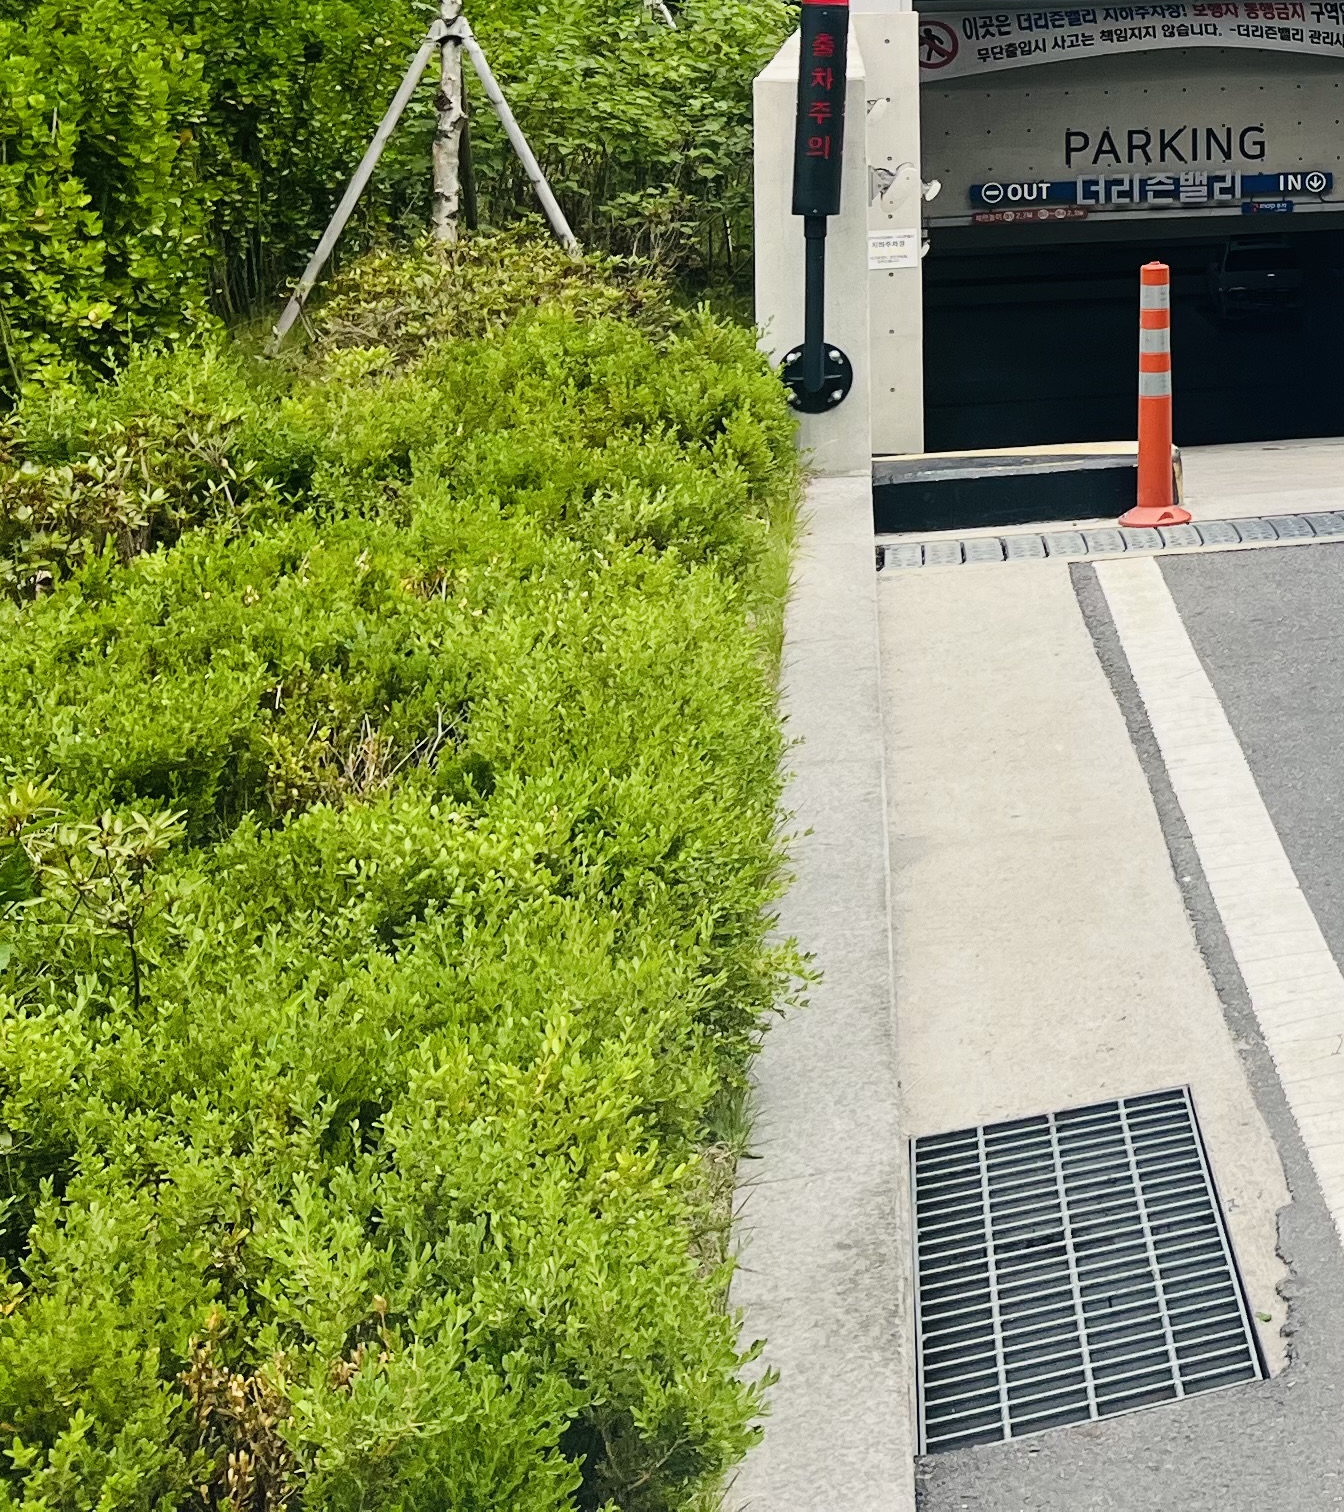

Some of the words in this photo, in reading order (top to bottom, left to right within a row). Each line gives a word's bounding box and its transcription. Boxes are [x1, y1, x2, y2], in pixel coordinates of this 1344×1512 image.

[962, 15, 1011, 40] 이곳은
[1016, 8, 1098, 33] 더리즌밸리
[1103, 3, 1187, 23] 지하주차장!
[1193, 2, 1239, 19] 보행자
[1244, 2, 1306, 23] 통행금지
[977, 37, 1047, 62] 무단출입시
[1051, 32, 1095, 50] 사고는
[1100, 24, 1157, 44] 책임지지
[1162, 23, 1223, 37] 않습니다.
[807, 33, 835, 159] 출차주의
[1065, 126, 1267, 167] PARKING
[1007, 182, 1051, 200] OUT
[1076, 170, 1242, 206] 더리즌밸리
[1279, 174, 1302, 191] IN
